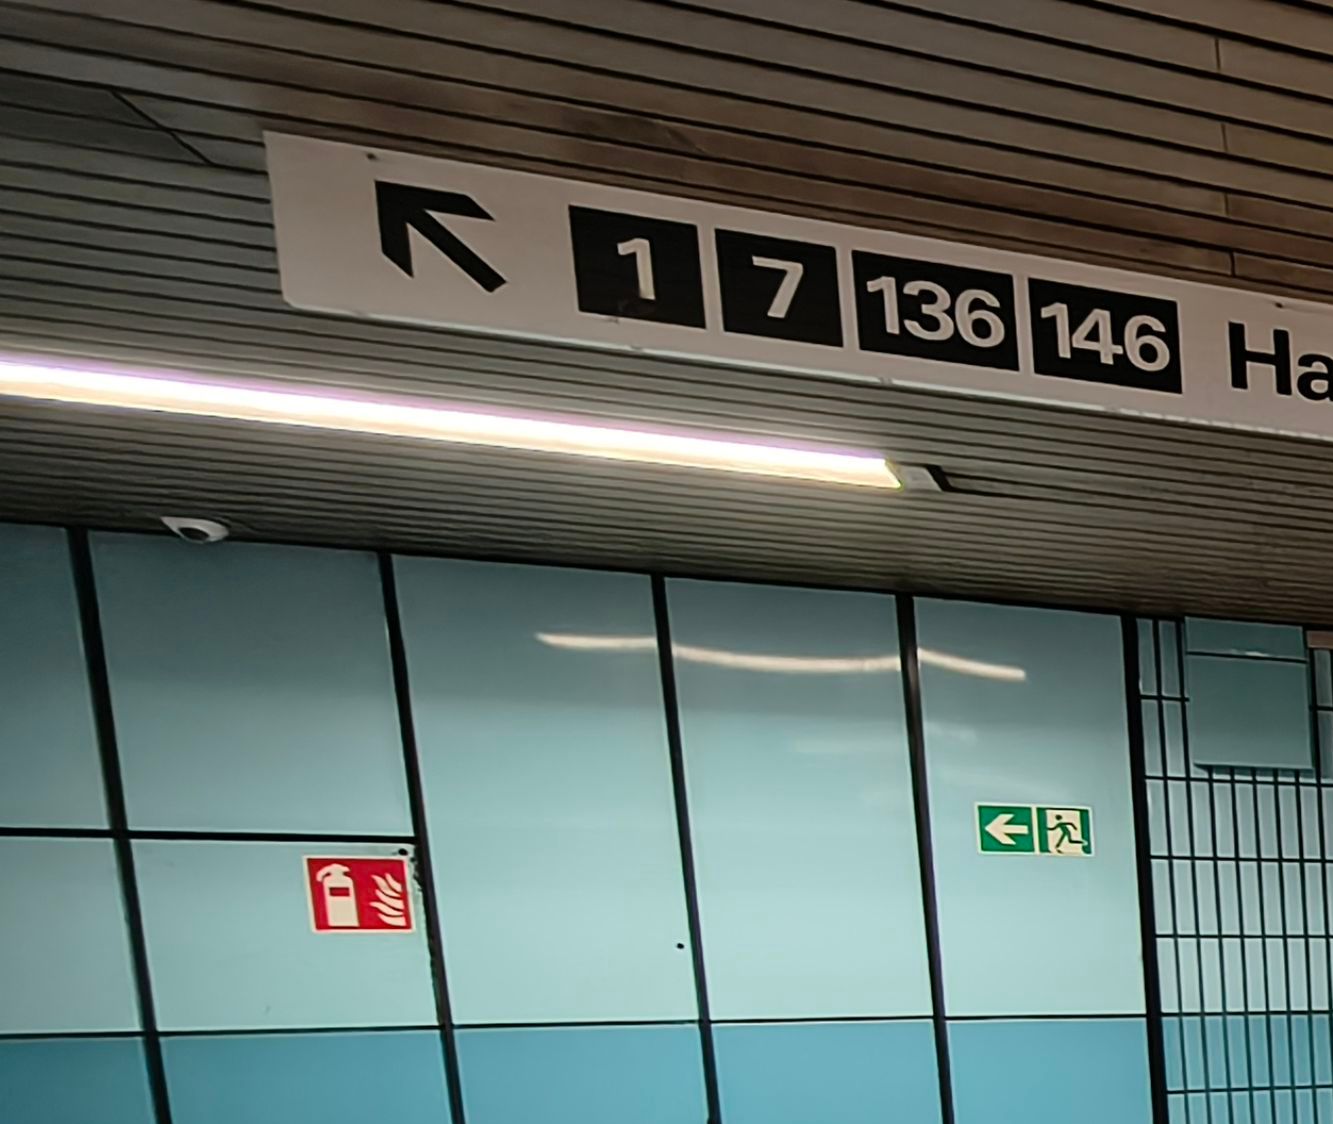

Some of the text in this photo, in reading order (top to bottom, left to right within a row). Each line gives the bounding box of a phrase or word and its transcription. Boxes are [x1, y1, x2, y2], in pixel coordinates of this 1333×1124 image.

[617, 237, 655, 300] 1
[752, 255, 804, 319] 7
[866, 275, 1006, 348] 136
[1040, 302, 1170, 372] 146
